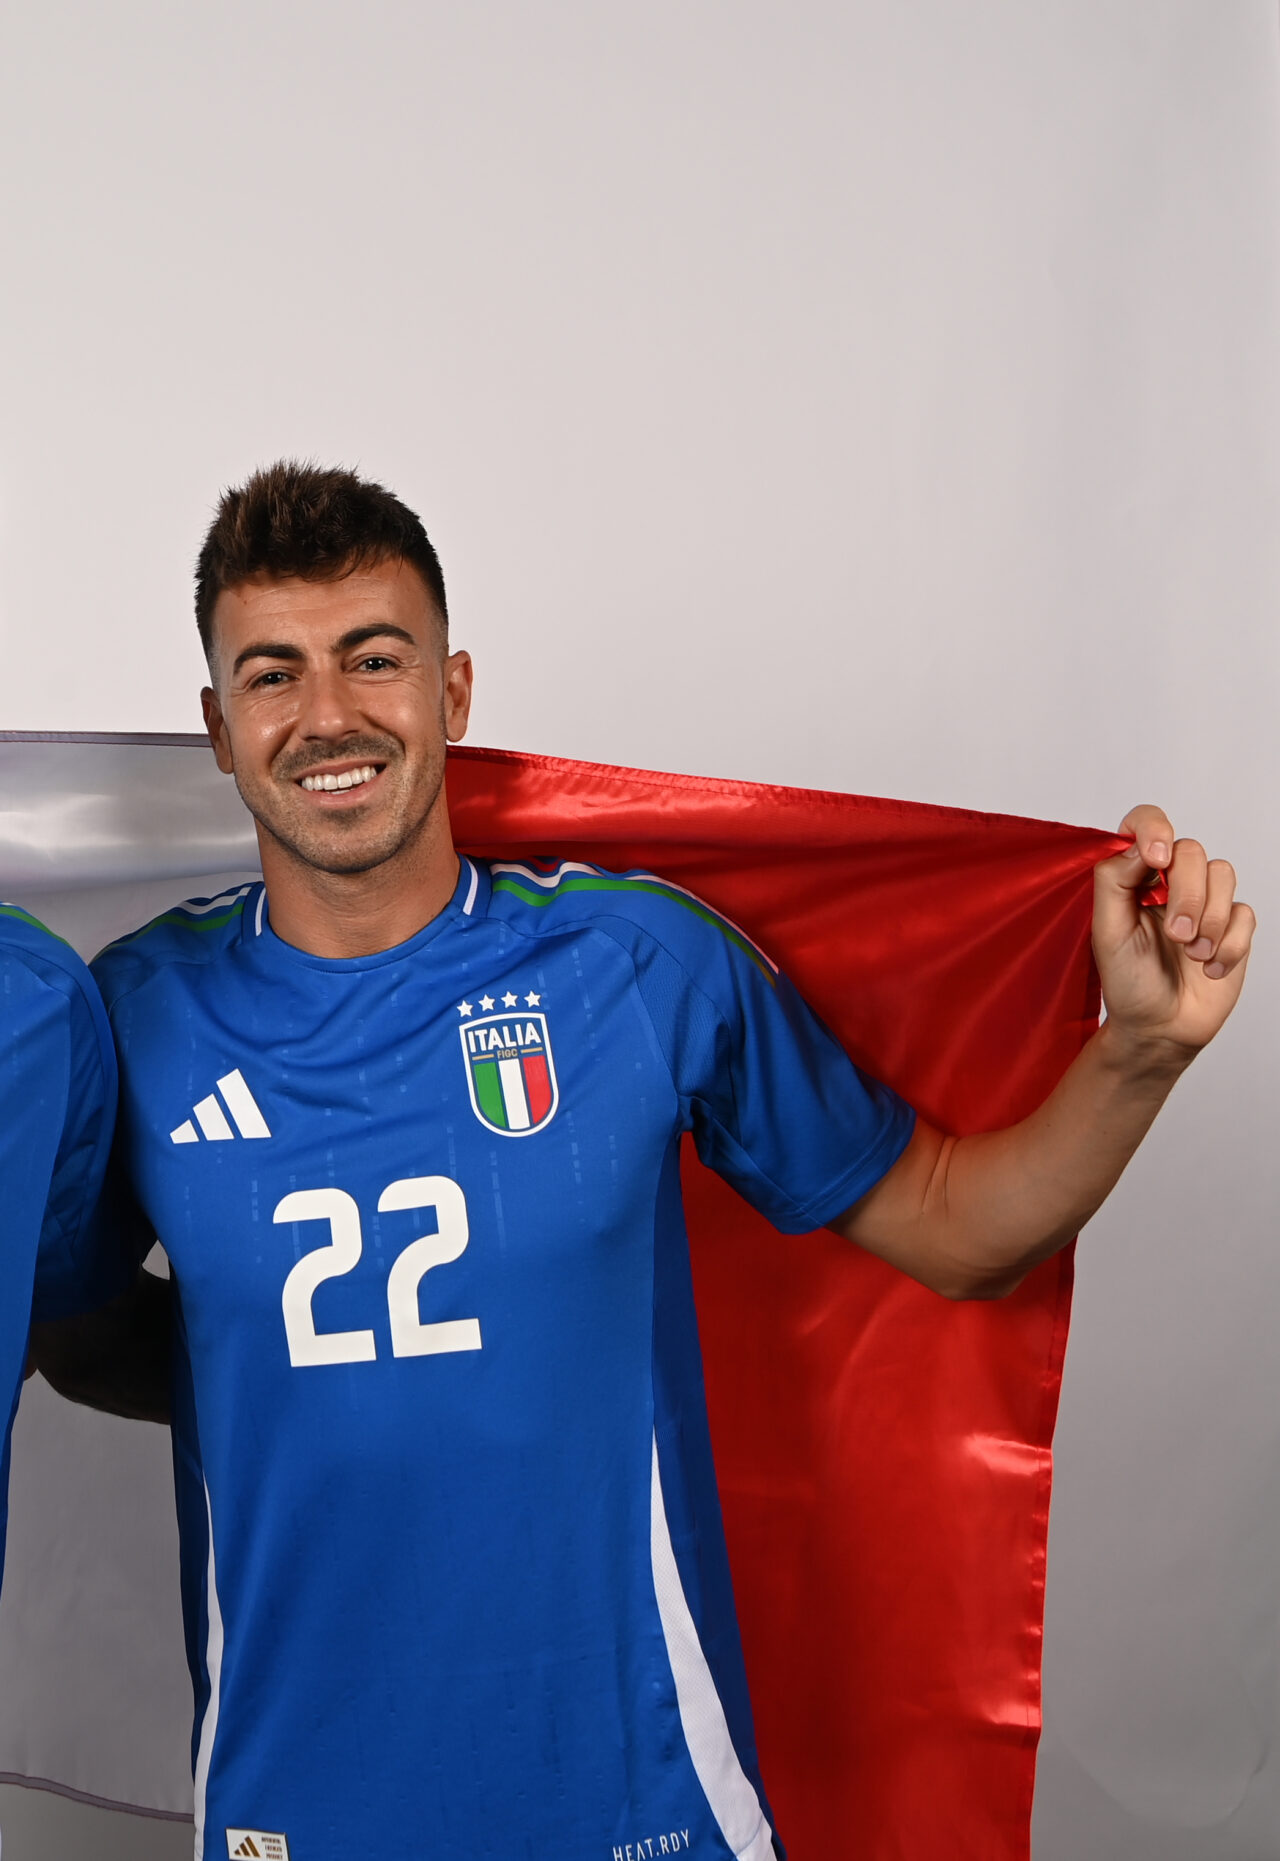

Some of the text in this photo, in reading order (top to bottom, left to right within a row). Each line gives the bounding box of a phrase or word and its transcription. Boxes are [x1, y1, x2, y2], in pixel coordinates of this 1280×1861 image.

[468, 1022, 541, 1053] ITALIA
[497, 1048, 518, 1060] FIGC
[273, 1175, 482, 1367] 22
[612, 1828, 689, 1861] HEAT.RDY
